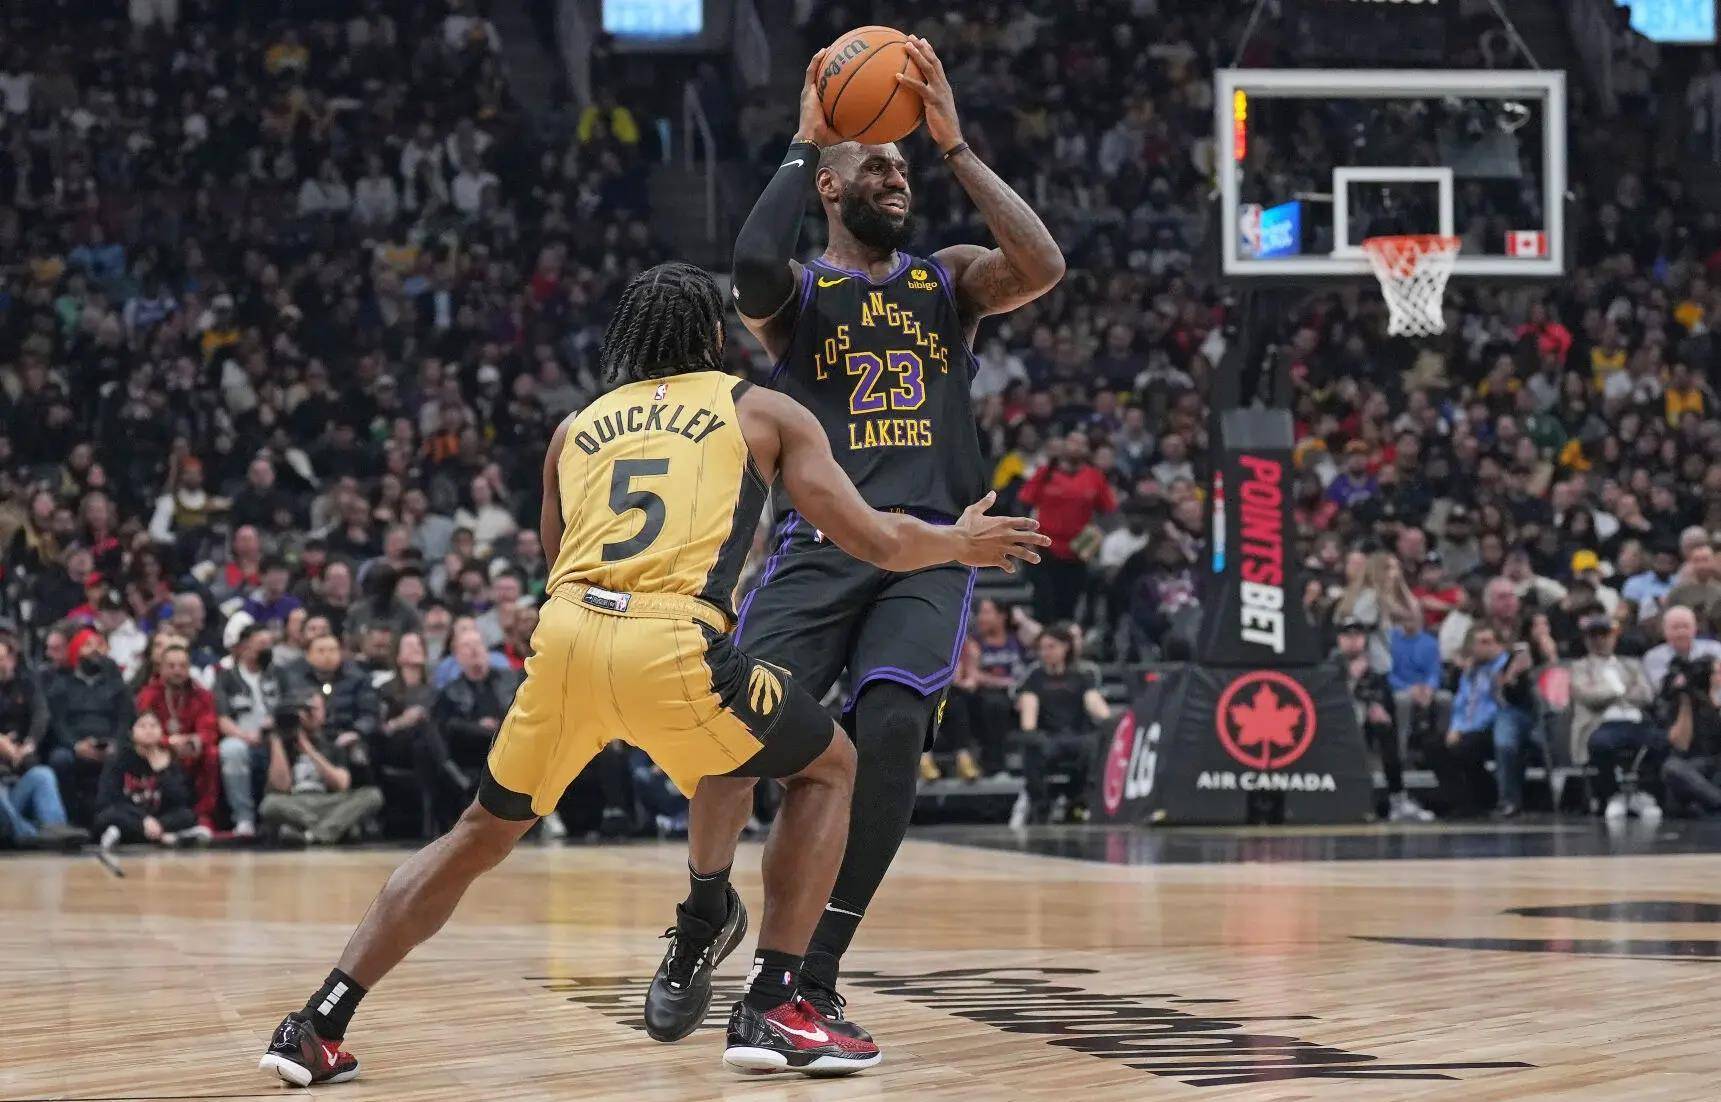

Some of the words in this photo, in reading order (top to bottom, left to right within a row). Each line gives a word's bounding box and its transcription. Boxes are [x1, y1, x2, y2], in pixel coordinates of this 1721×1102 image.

[908, 280, 938, 291] bibigo
[815, 325, 850, 381] LOS
[861, 291, 948, 374] ANGELES
[845, 350, 926, 415] 23
[574, 404, 726, 456] QUICKLEY
[848, 419, 933, 450] LAKERS
[601, 458, 670, 562] 5
[1239, 454, 1286, 655] POINTSBET
[1197, 771, 1240, 791] AIR
[1241, 771, 1337, 792] CANADA
[838, 968, 1540, 1087] Scotiabank
